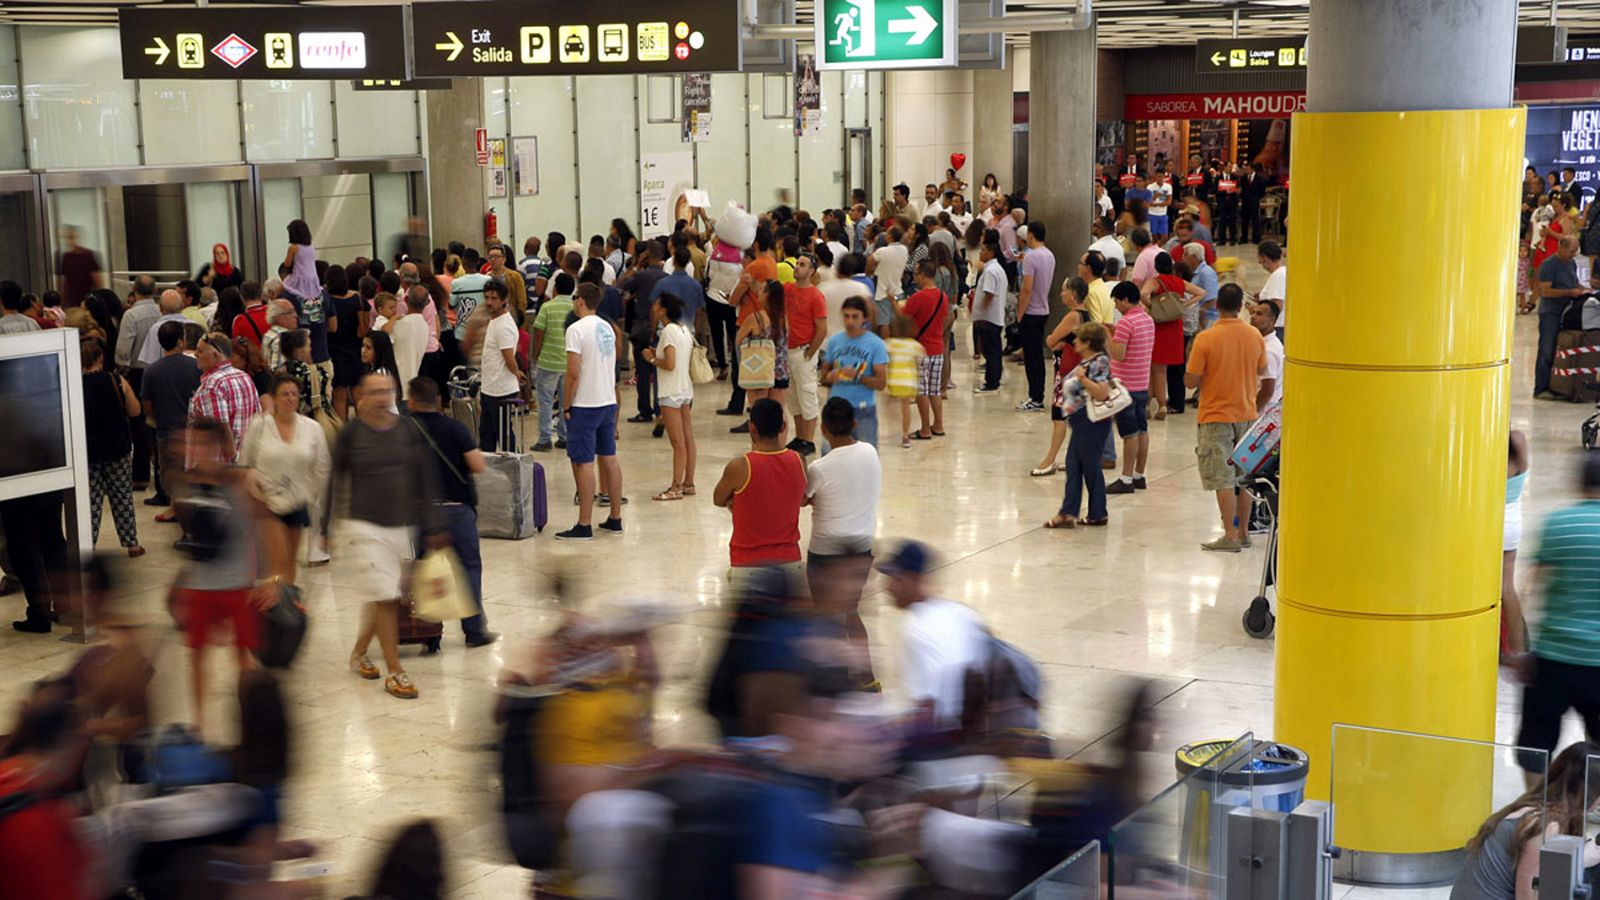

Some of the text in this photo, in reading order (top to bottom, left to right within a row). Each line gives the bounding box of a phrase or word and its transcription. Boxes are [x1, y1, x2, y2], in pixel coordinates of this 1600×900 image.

[471, 29, 491, 43] Exit
[639, 35, 655, 50] BUS
[529, 33, 544, 58] P
[472, 47, 513, 63] Salida
[1281, 52, 1294, 62] 10
[1146, 101, 1197, 113] SABOREA
[1571, 110, 1600, 130] MEN
[1562, 130, 1600, 151] VEGET
[643, 206, 659, 227] 1€
